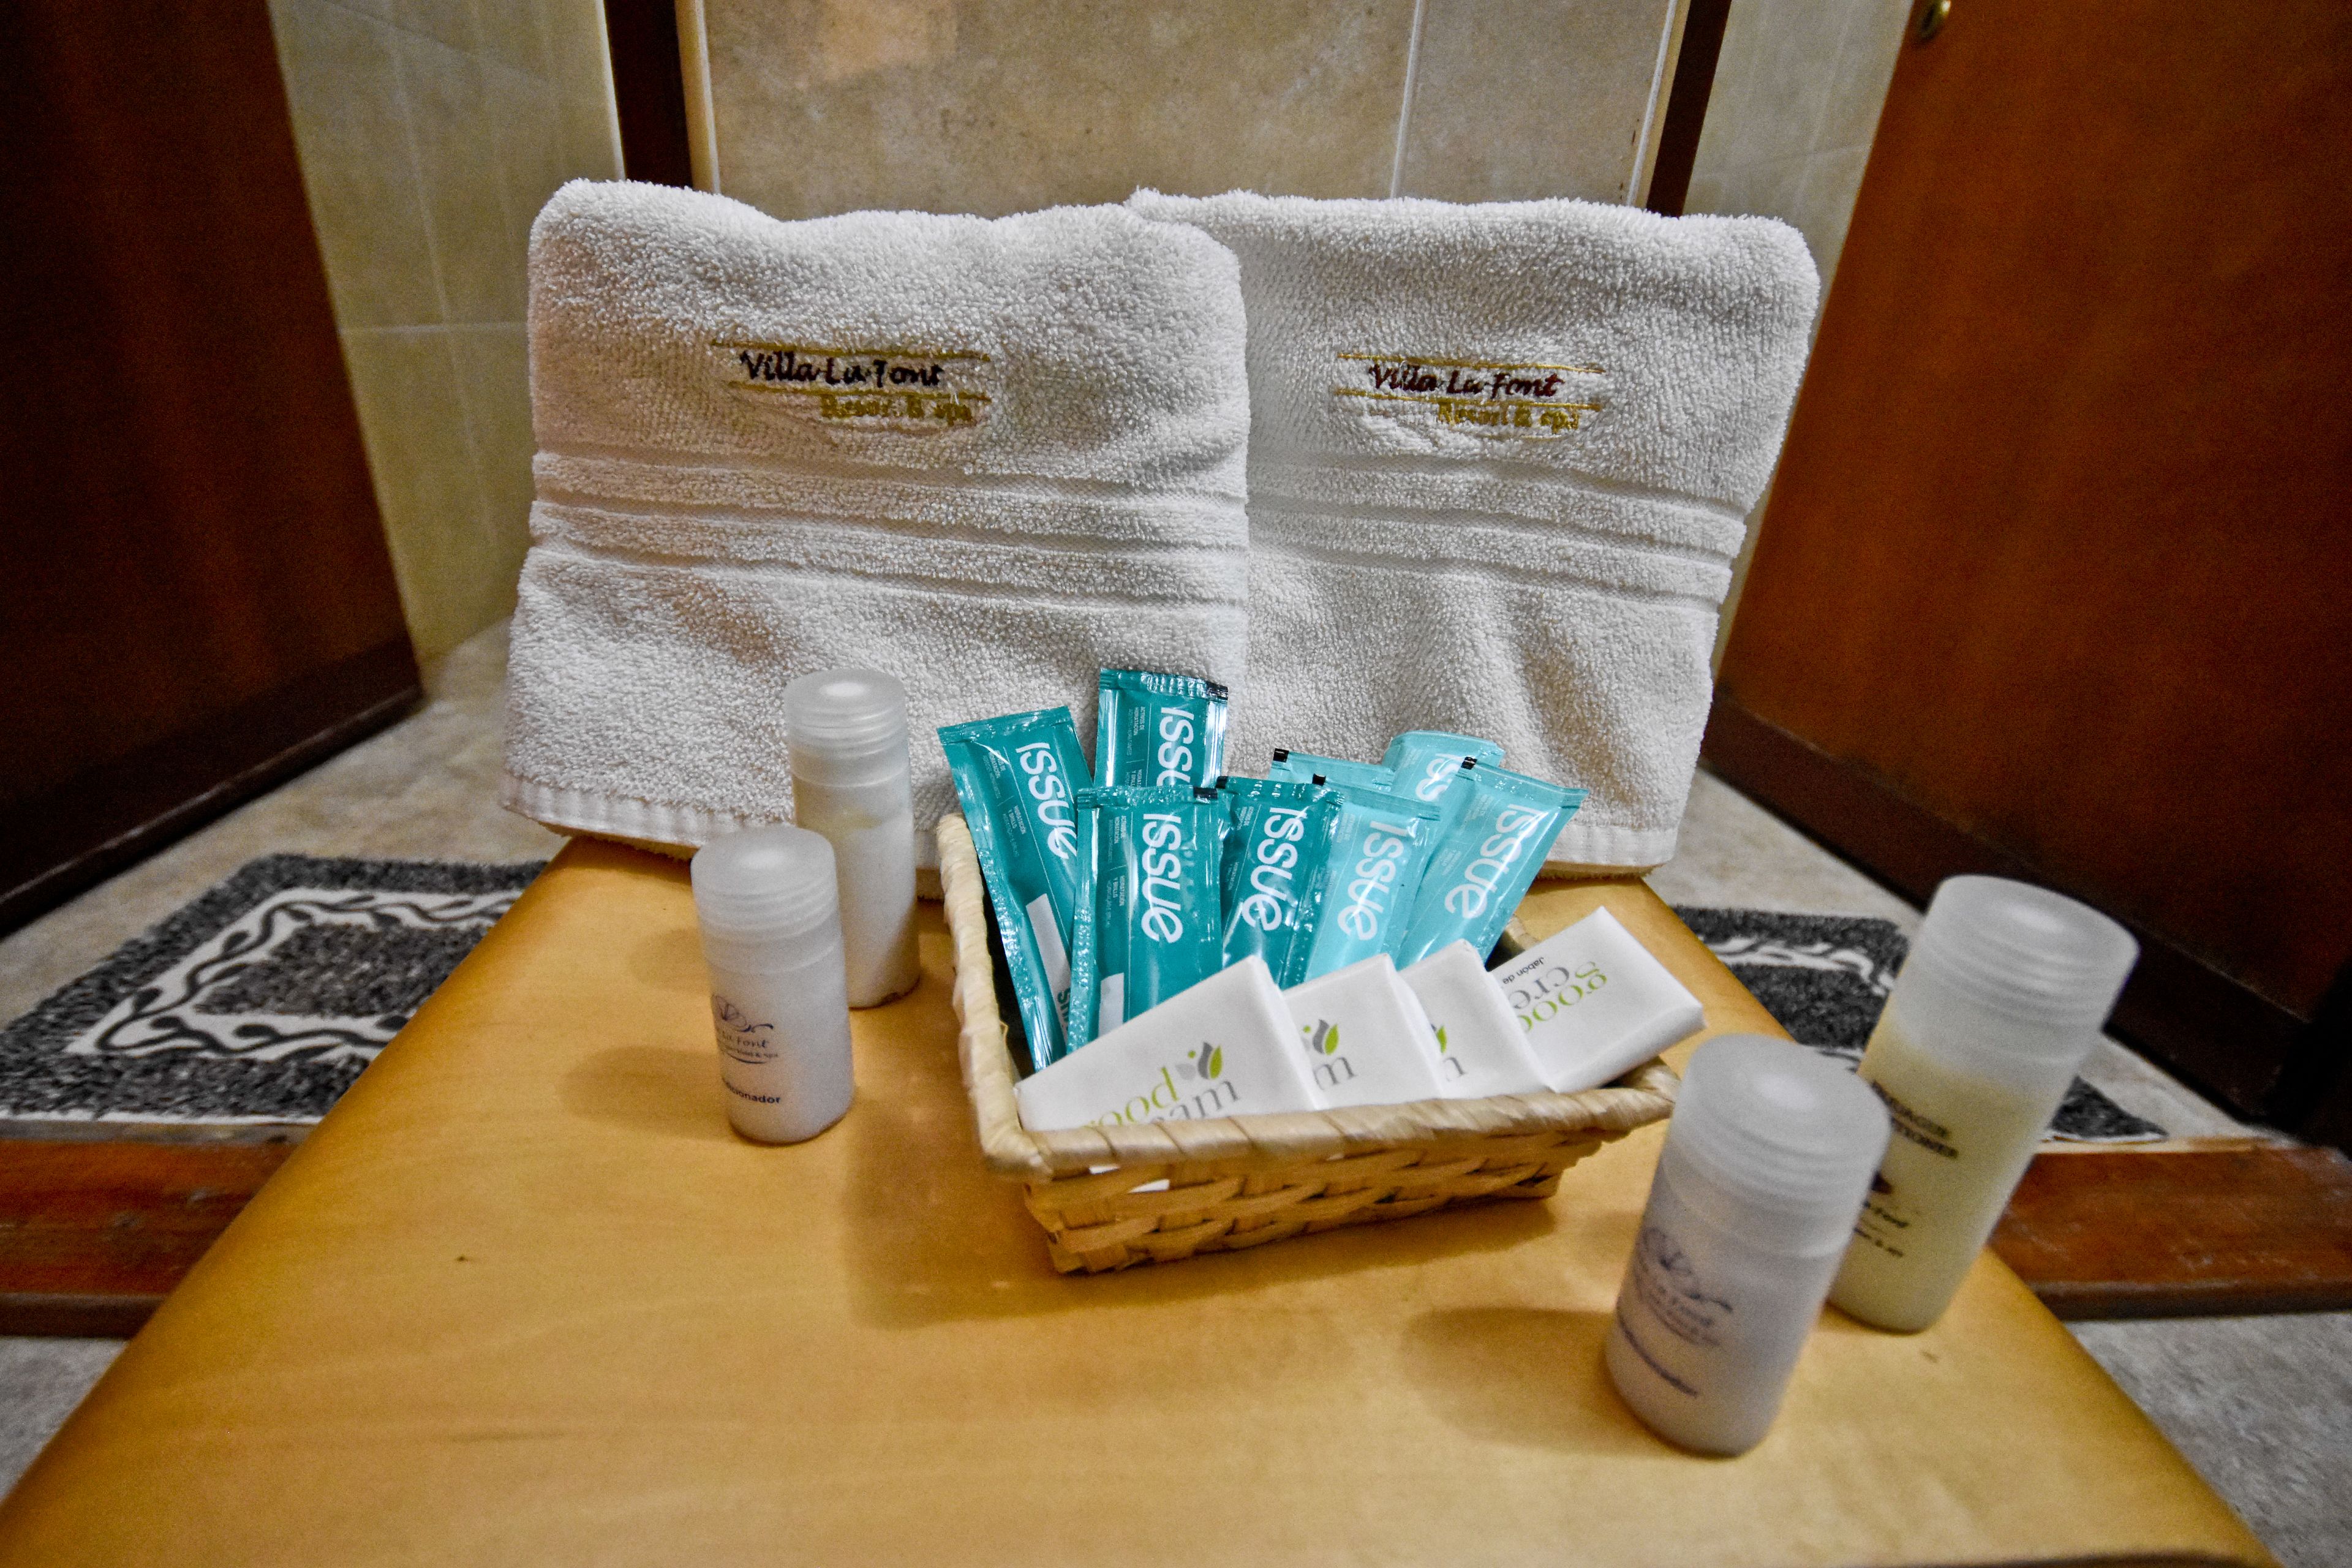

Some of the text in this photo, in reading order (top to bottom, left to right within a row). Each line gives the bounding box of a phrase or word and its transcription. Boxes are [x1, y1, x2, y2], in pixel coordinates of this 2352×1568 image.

[739, 350, 818, 381] Villa
[824, 357, 867, 385] La
[1368, 363, 1438, 392] Villa
[1446, 370, 1485, 394] La
[1501, 973, 1516, 986] de
